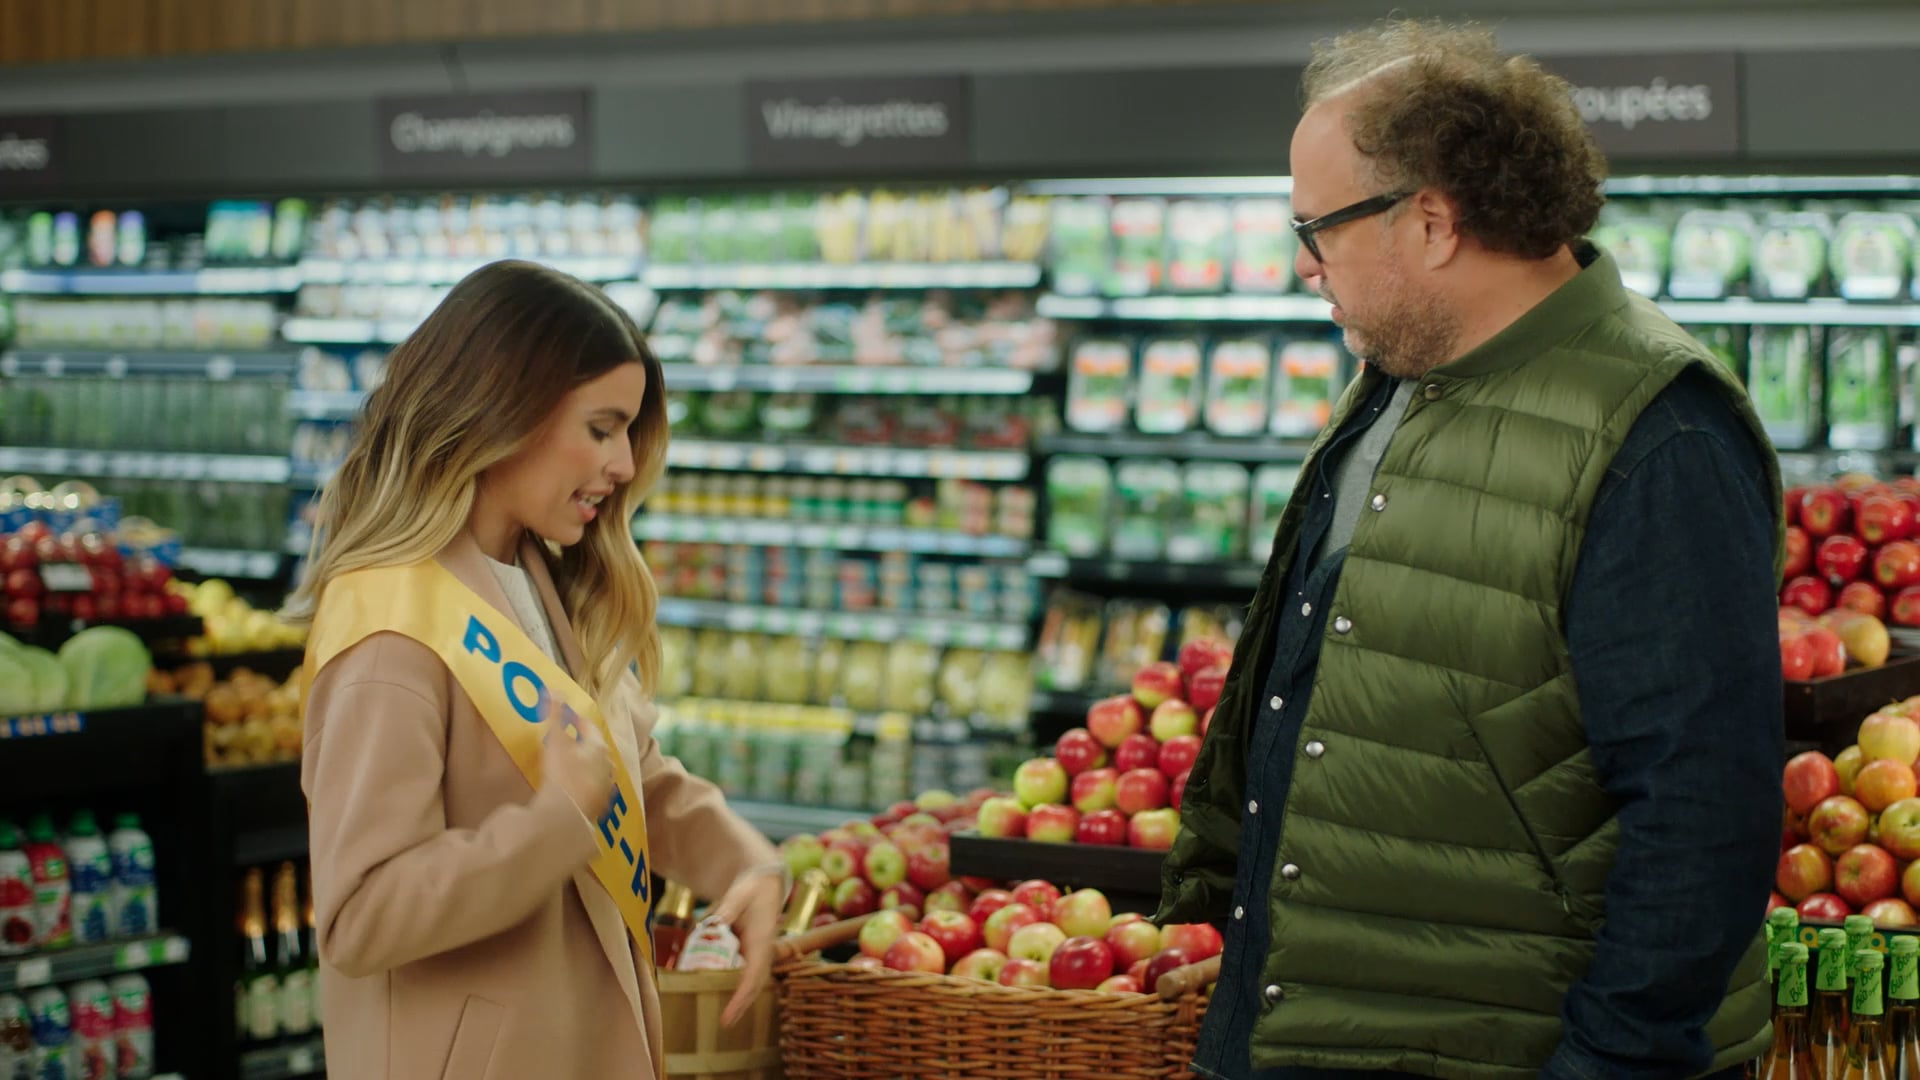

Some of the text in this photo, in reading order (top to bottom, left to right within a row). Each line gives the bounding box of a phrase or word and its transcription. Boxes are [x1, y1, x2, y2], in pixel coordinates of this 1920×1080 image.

[762, 97, 948, 147] Vinaigrettes
[1568, 76, 1713, 131] oupées
[389, 107, 575, 159] Champignons
